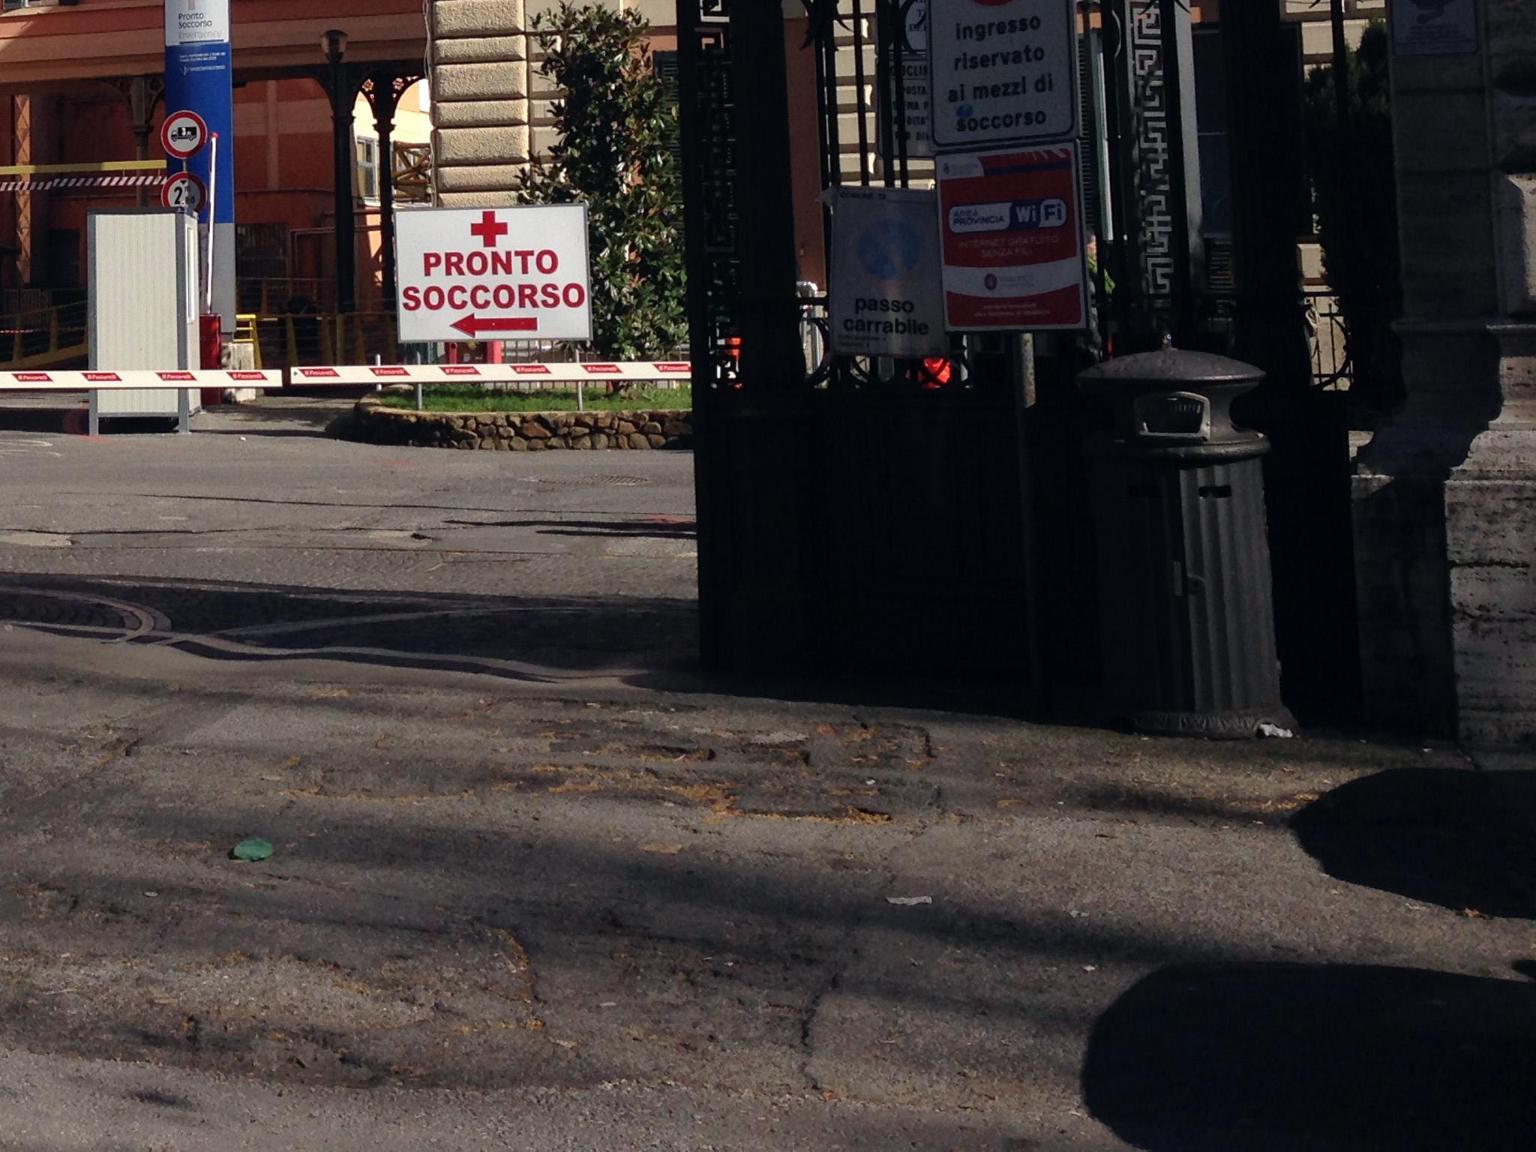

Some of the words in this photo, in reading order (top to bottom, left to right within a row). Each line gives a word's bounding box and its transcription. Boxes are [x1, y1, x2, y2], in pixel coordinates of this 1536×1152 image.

[178, 12, 205, 21] Pronto
[178, 20, 213, 29] Soccorso
[955, 14, 1041, 42] ingresso
[954, 46, 1045, 72] riservato
[948, 83, 964, 103] ai
[972, 78, 1026, 100] mezzi
[1034, 73, 1053, 93] di
[955, 110, 1047, 133] soccorso
[953, 215, 1005, 226] PROVINCIA
[423, 249, 559, 277] PRONTO
[402, 282, 585, 311] SOCCORSO
[855, 297, 914, 315] passo
[844, 318, 929, 336] carrabile
